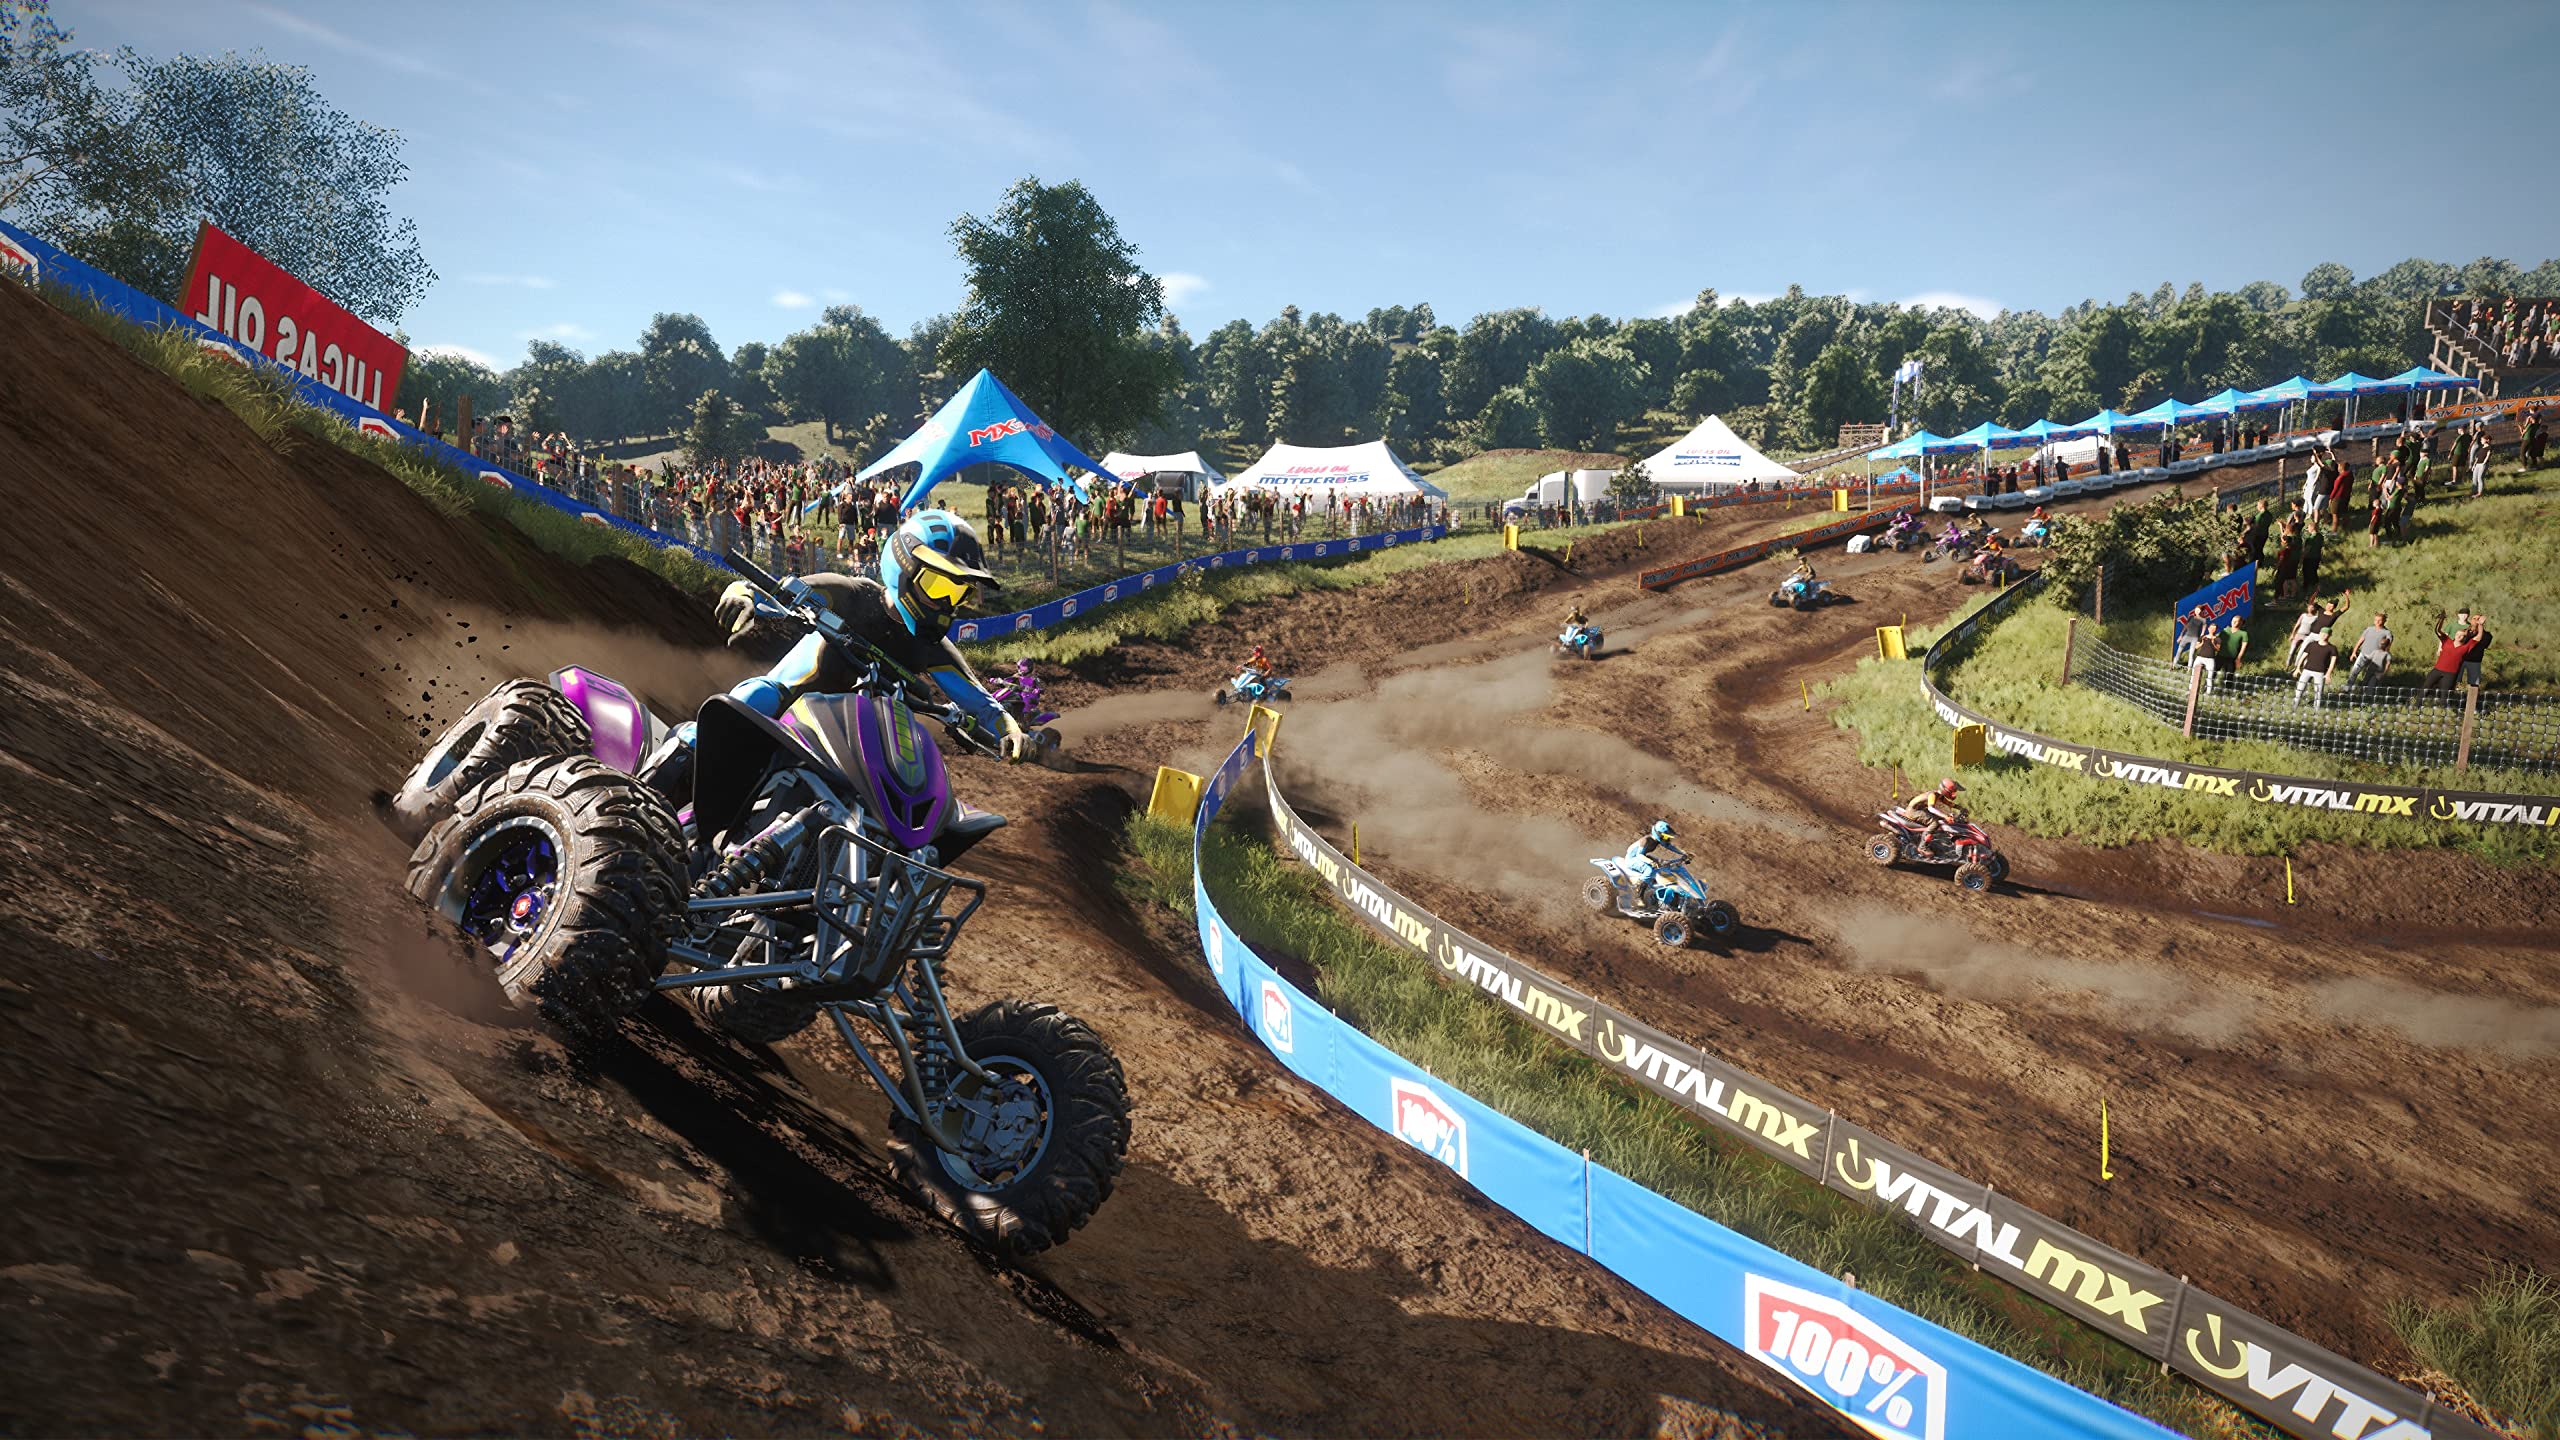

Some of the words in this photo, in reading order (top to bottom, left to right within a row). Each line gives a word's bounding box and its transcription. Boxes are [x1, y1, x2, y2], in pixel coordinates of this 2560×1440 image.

[1259, 474, 1370, 485] MOTOCROSS
[1286, 466, 1328, 474] LUCAS
[1330, 465, 1350, 473] OIL
[1402, 1098, 1456, 1166] 100%
[1769, 1309, 1917, 1428] 100%
